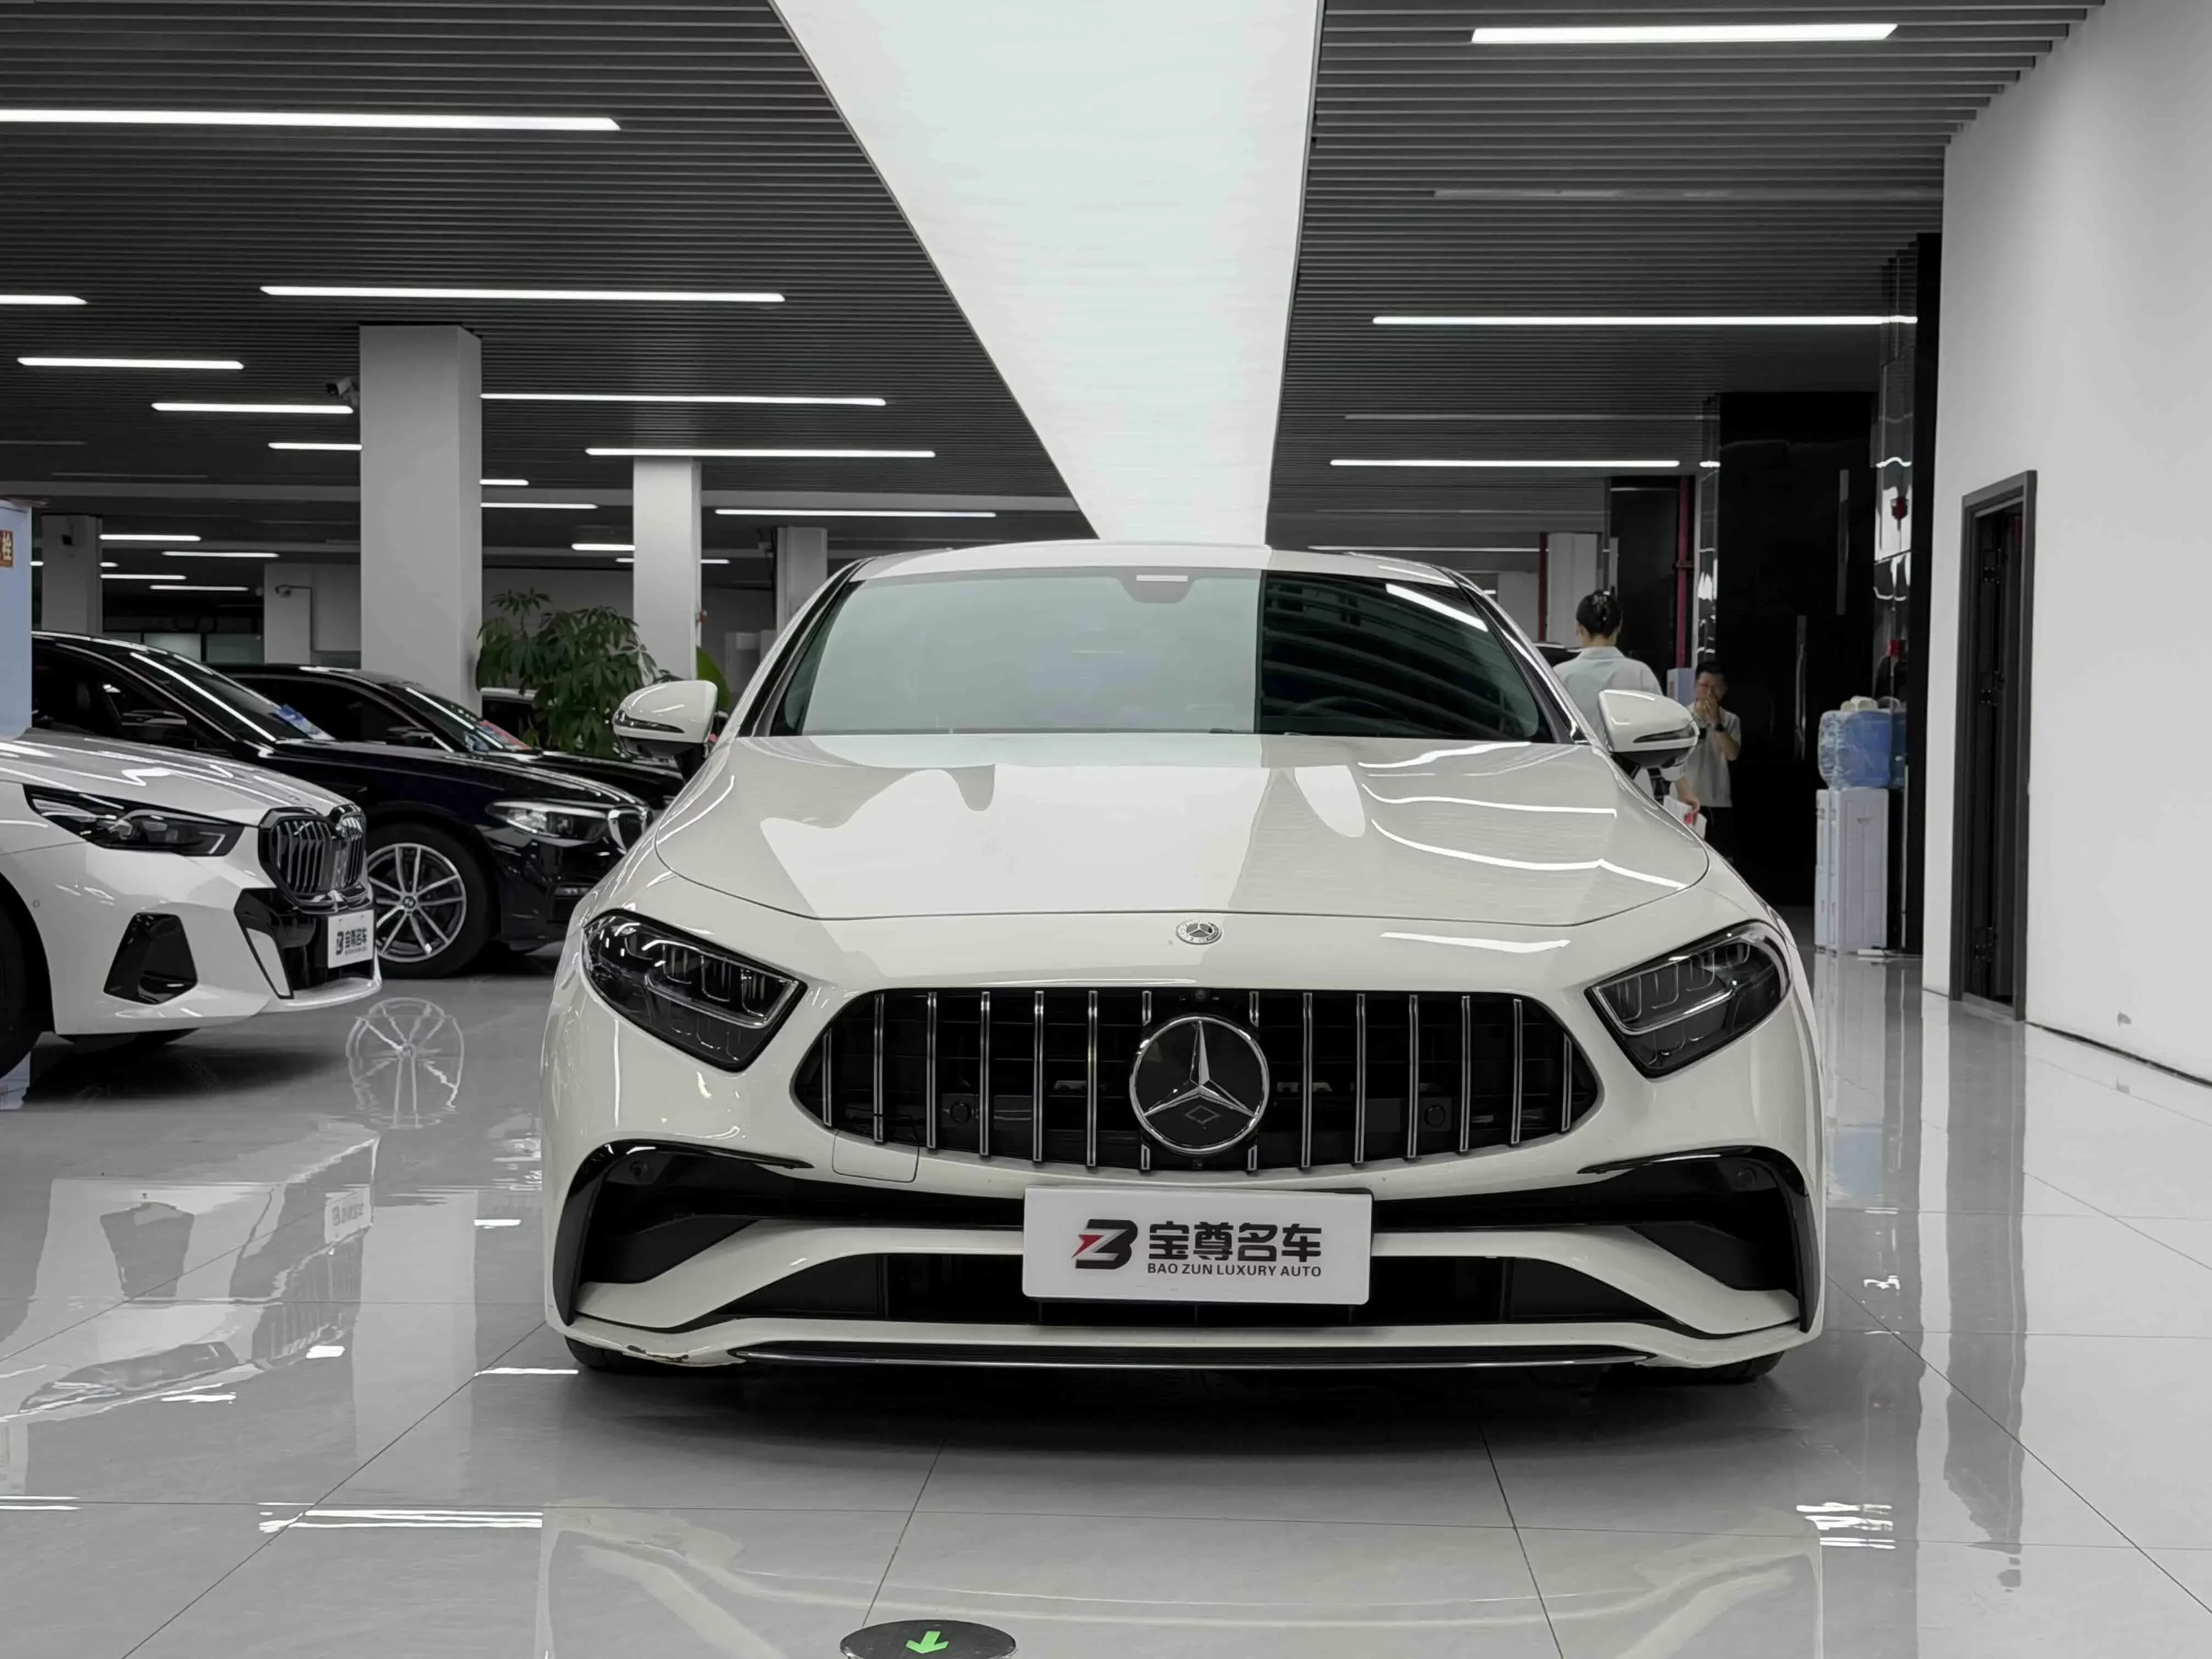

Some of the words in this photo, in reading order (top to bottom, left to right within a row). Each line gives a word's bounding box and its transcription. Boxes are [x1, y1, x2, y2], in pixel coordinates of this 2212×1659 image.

[1149, 1221, 1322, 1262] 宝尊名车
[1148, 1263, 1178, 1274] BAO
[1182, 1263, 1212, 1275] ZUN
[1217, 1264, 1277, 1276] LUXURY
[1280, 1266, 1321, 1277] AUTO
